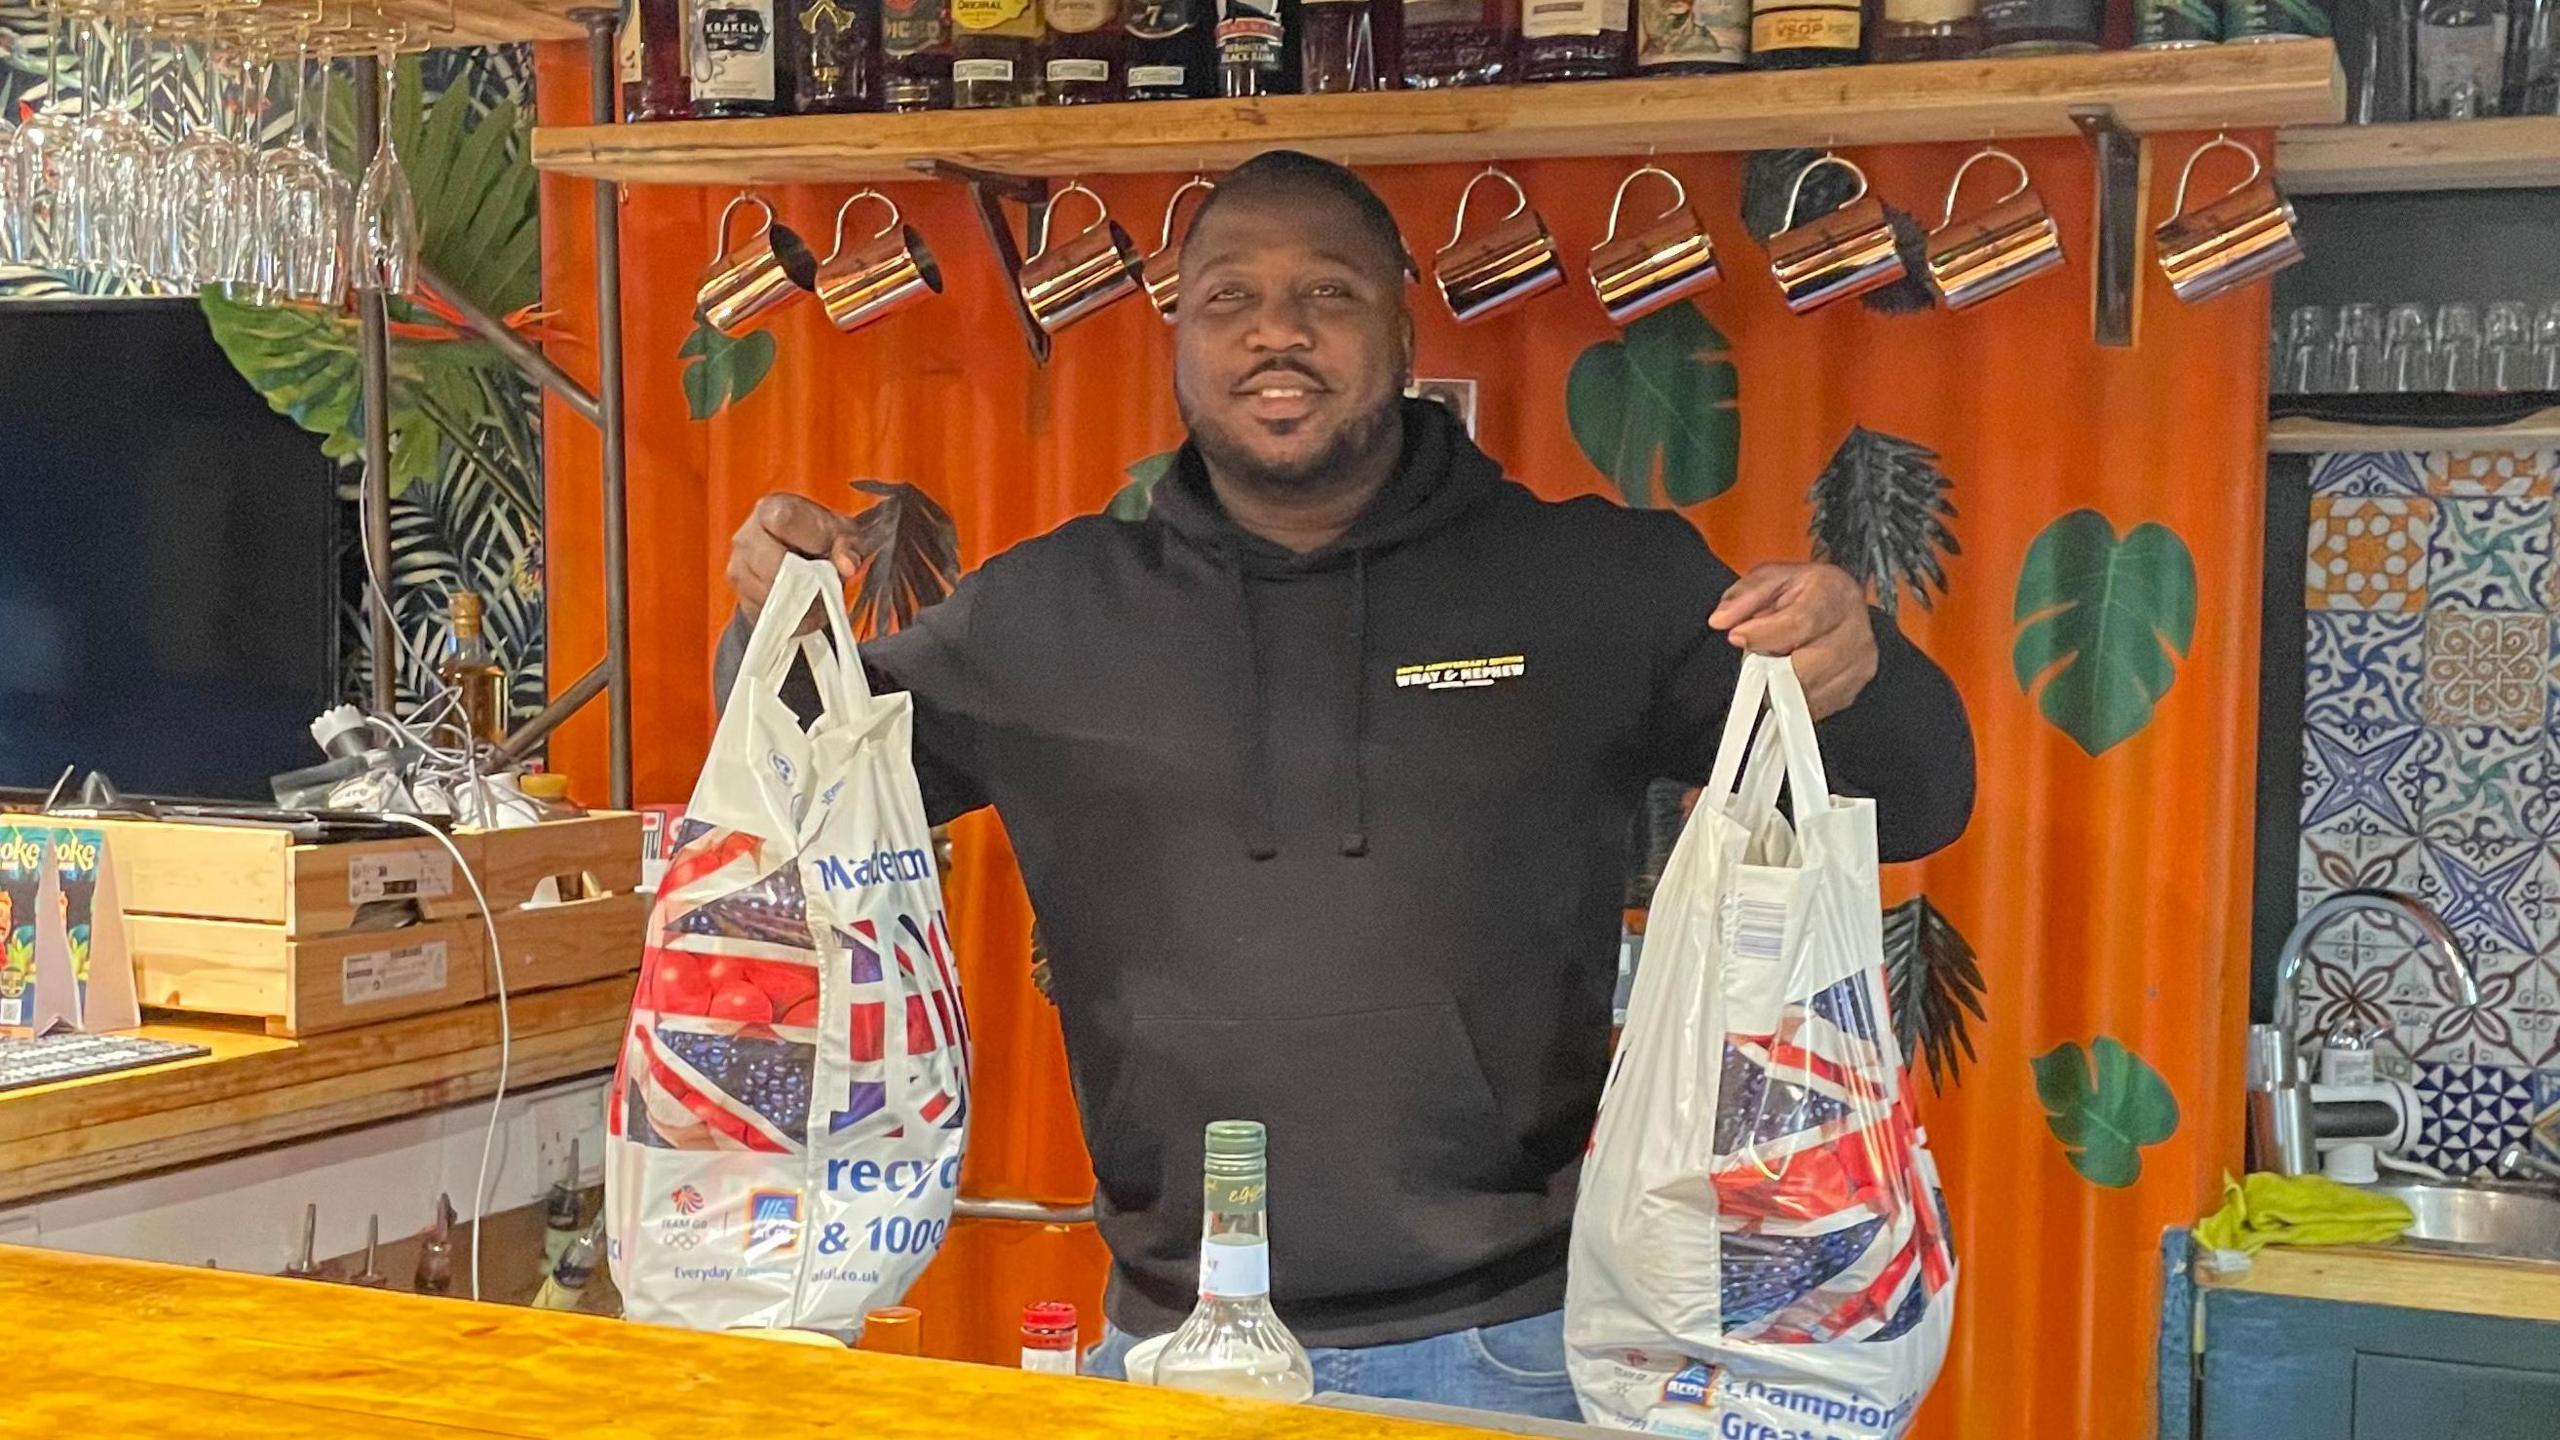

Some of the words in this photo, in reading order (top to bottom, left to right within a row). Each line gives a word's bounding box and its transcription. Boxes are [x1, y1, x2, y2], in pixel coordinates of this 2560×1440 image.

[1147, 5, 1161, 26] 7
[705, 22, 759, 33] KRAKEN
[1396, 670, 1440, 688] WRAY
[1443, 669, 1459, 682] &
[1460, 663, 1525, 681] NEPHEW
[55, 836, 97, 872] oke
[818, 1222, 849, 1255] &
[674, 1266, 732, 1282] Everyday
